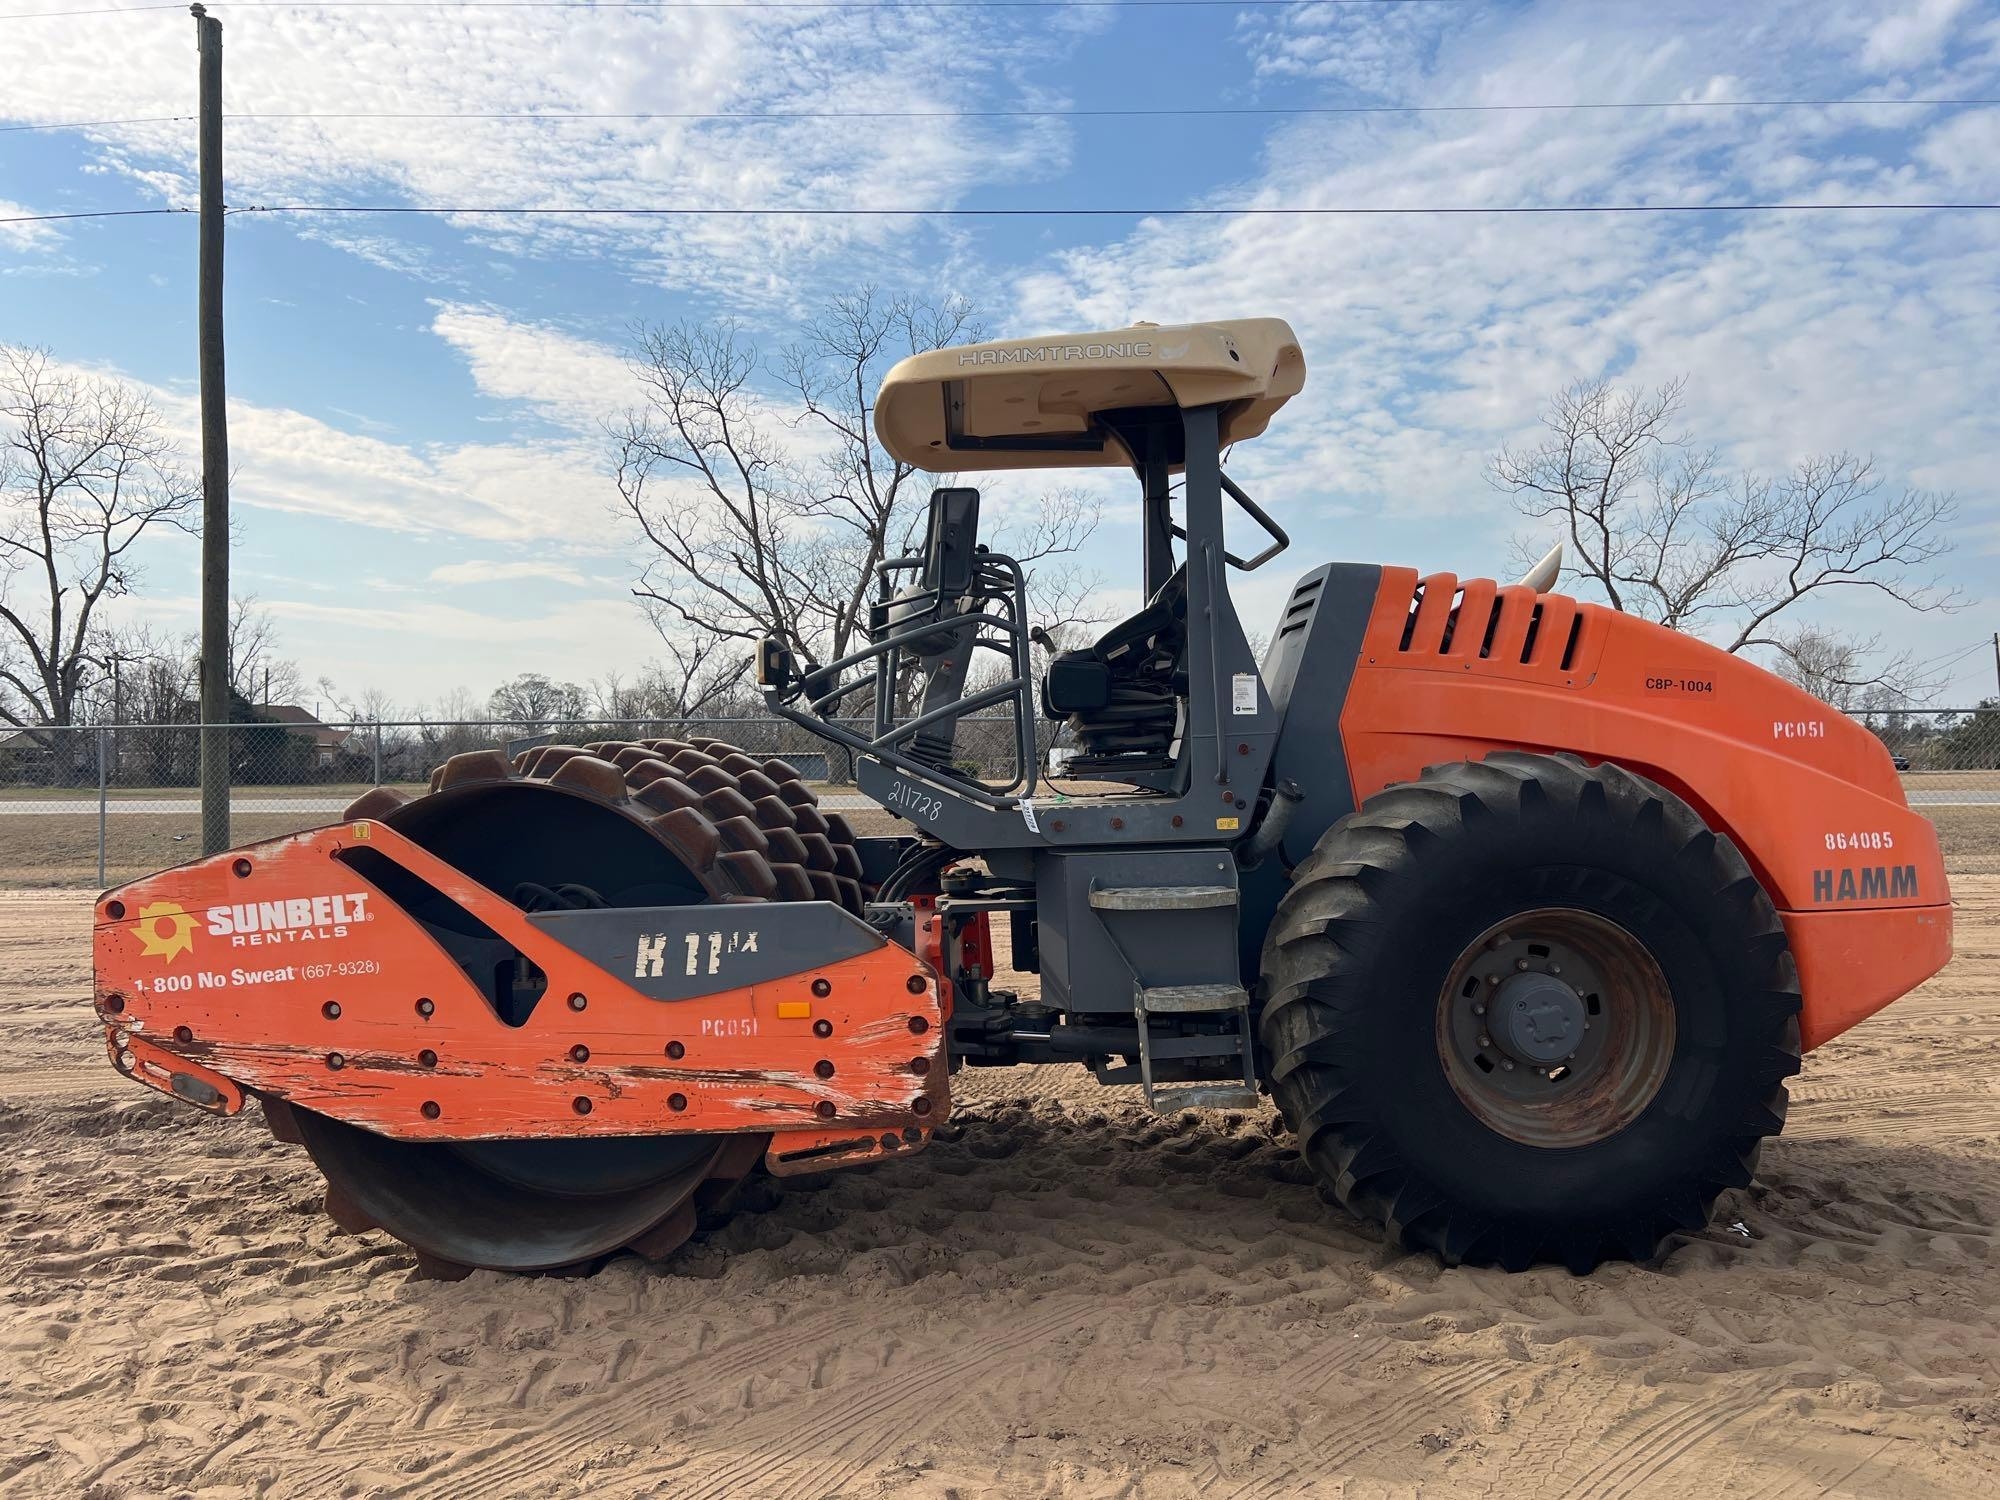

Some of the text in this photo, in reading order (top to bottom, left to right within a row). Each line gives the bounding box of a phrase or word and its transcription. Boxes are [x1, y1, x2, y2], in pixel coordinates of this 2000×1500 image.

[959, 343, 1152, 366] HAMMTRONIC
[1645, 677, 1713, 693] C8P-1004
[888, 781, 943, 821] 211728
[1824, 831, 1894, 850] 864085
[1813, 864, 1919, 903] HAMM
[232, 925, 348, 948] RENTALS
[635, 932, 667, 977] H
[198, 971, 227, 989] No
[231, 965, 296, 986] Sweat
[301, 960, 380, 982] (667-9328)
